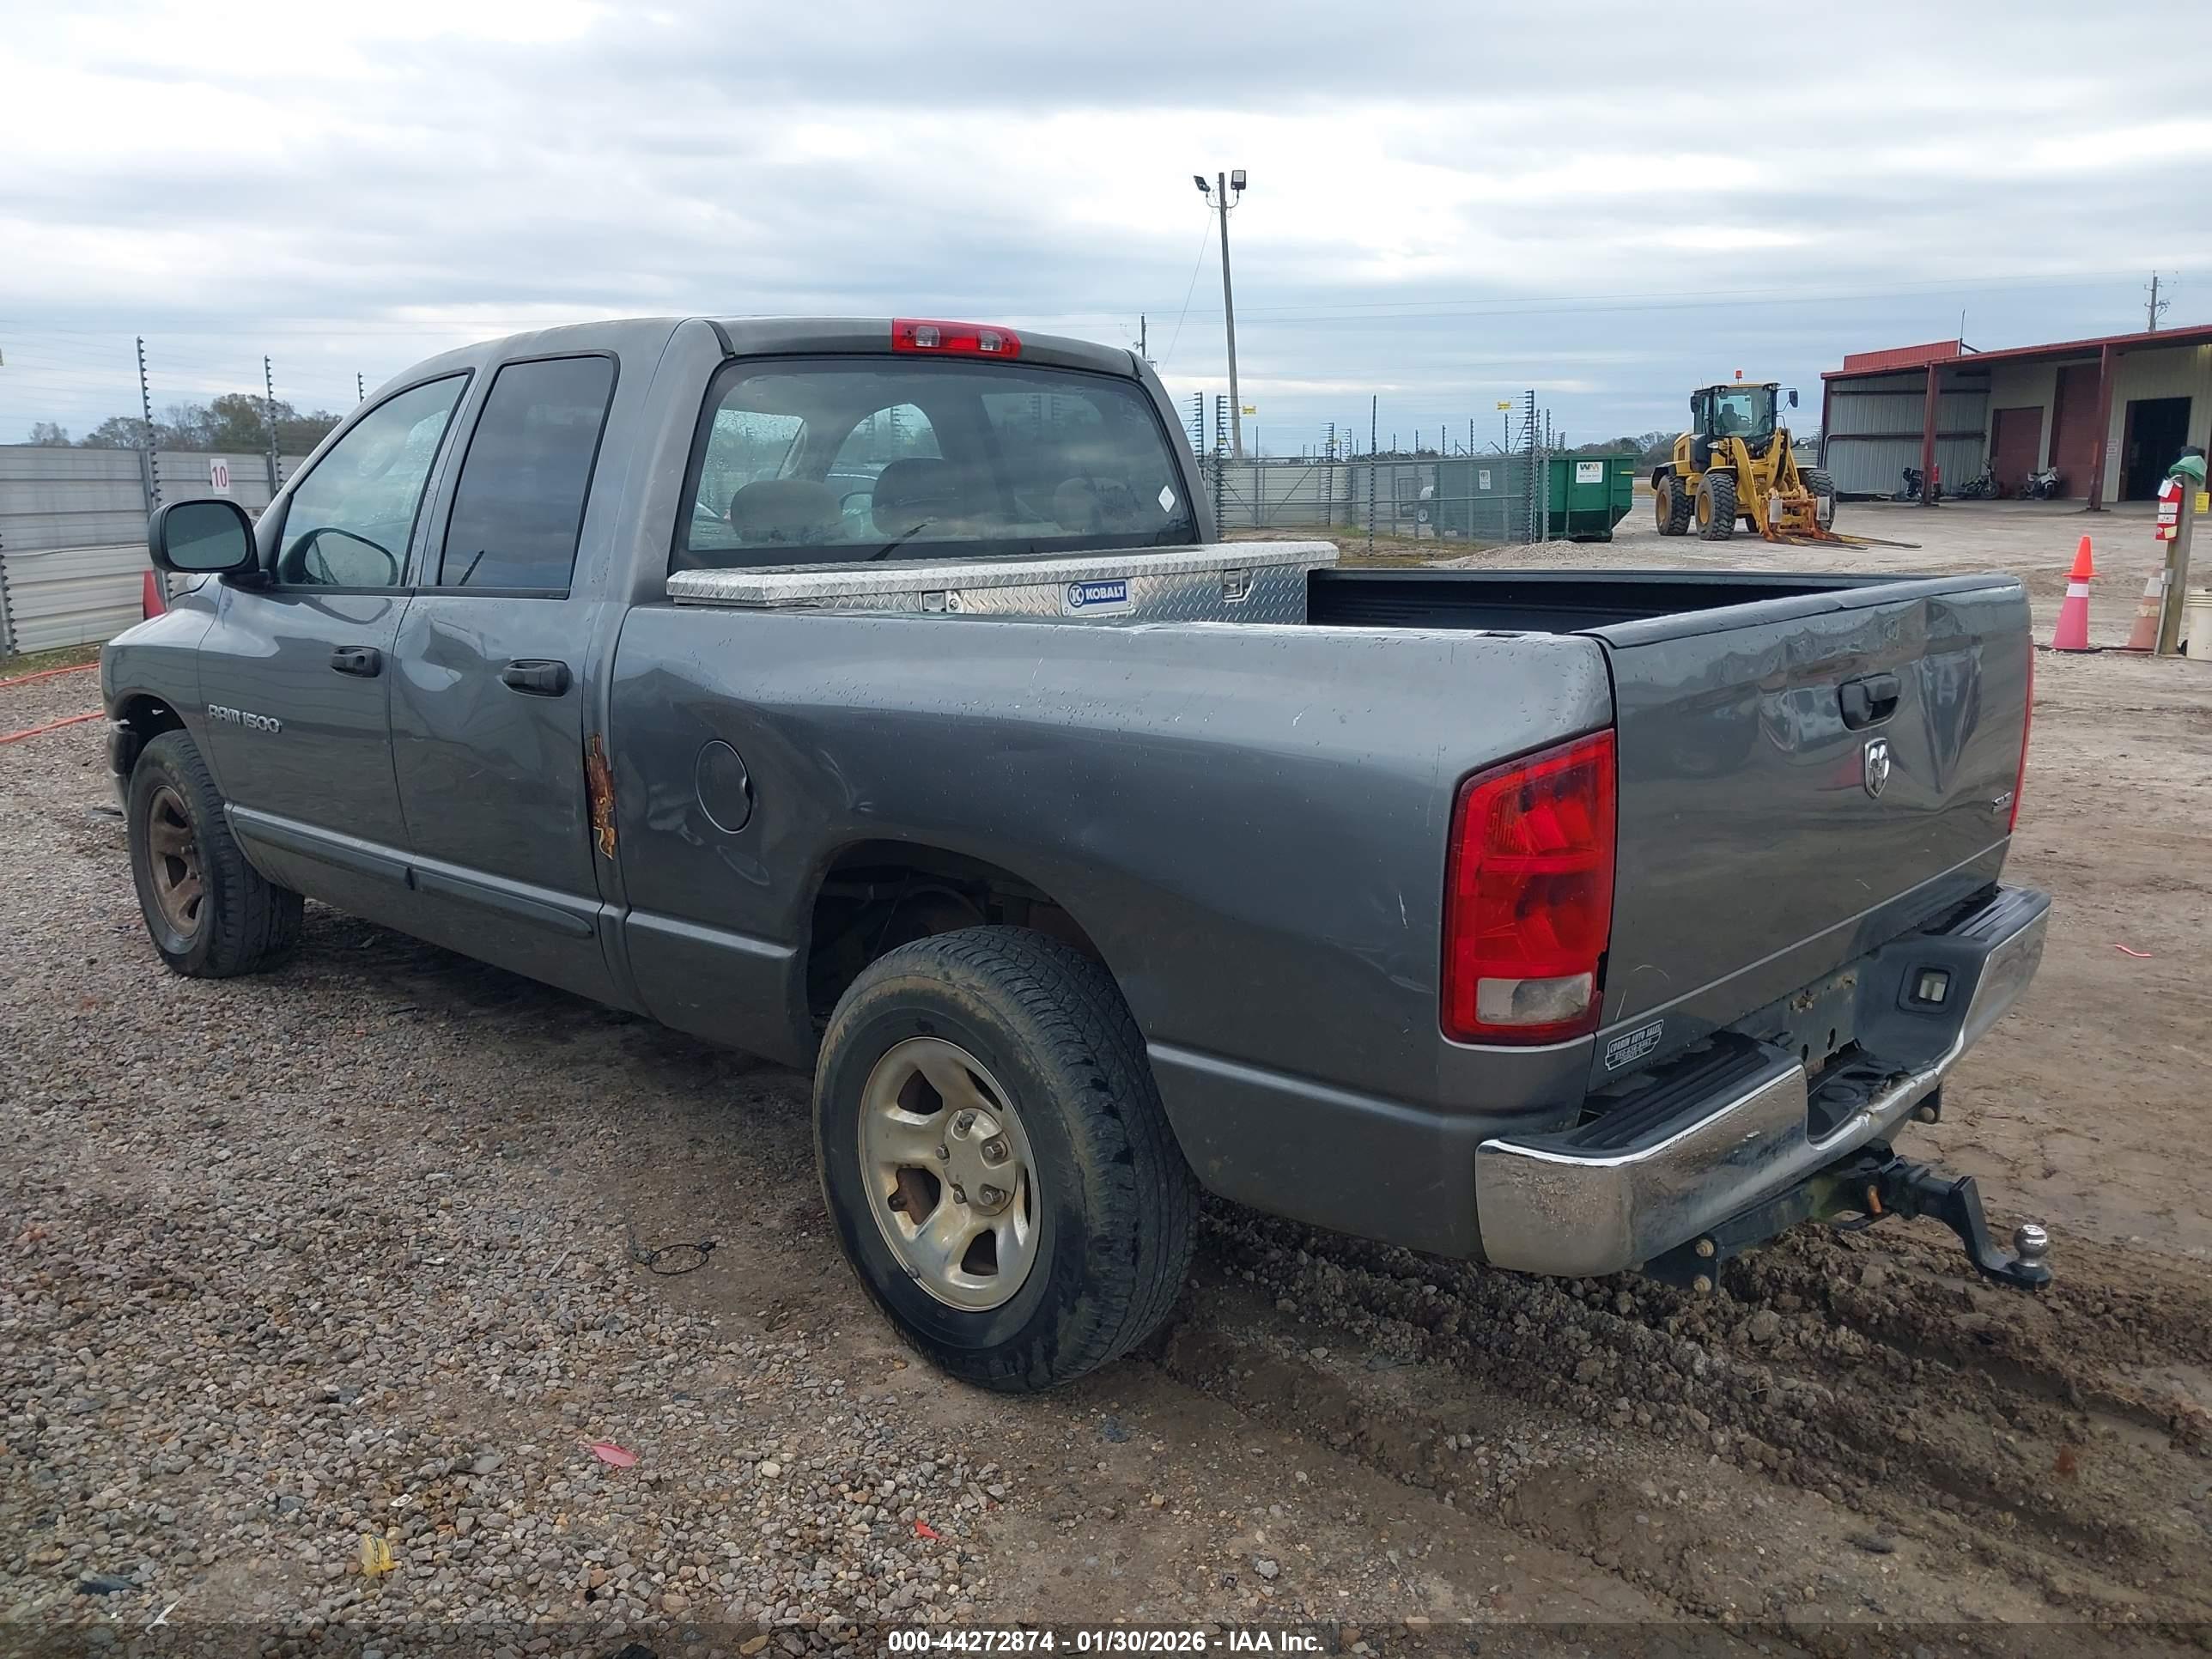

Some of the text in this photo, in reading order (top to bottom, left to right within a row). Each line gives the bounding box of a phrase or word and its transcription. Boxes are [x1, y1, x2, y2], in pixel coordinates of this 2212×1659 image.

[212, 466, 228, 488] 10
[1085, 586, 1124, 600] KOBALT
[208, 704, 281, 733] RAM 1500
[1632, 1030, 1646, 1045] AUTO
[1646, 1024, 1662, 1038] SALES
